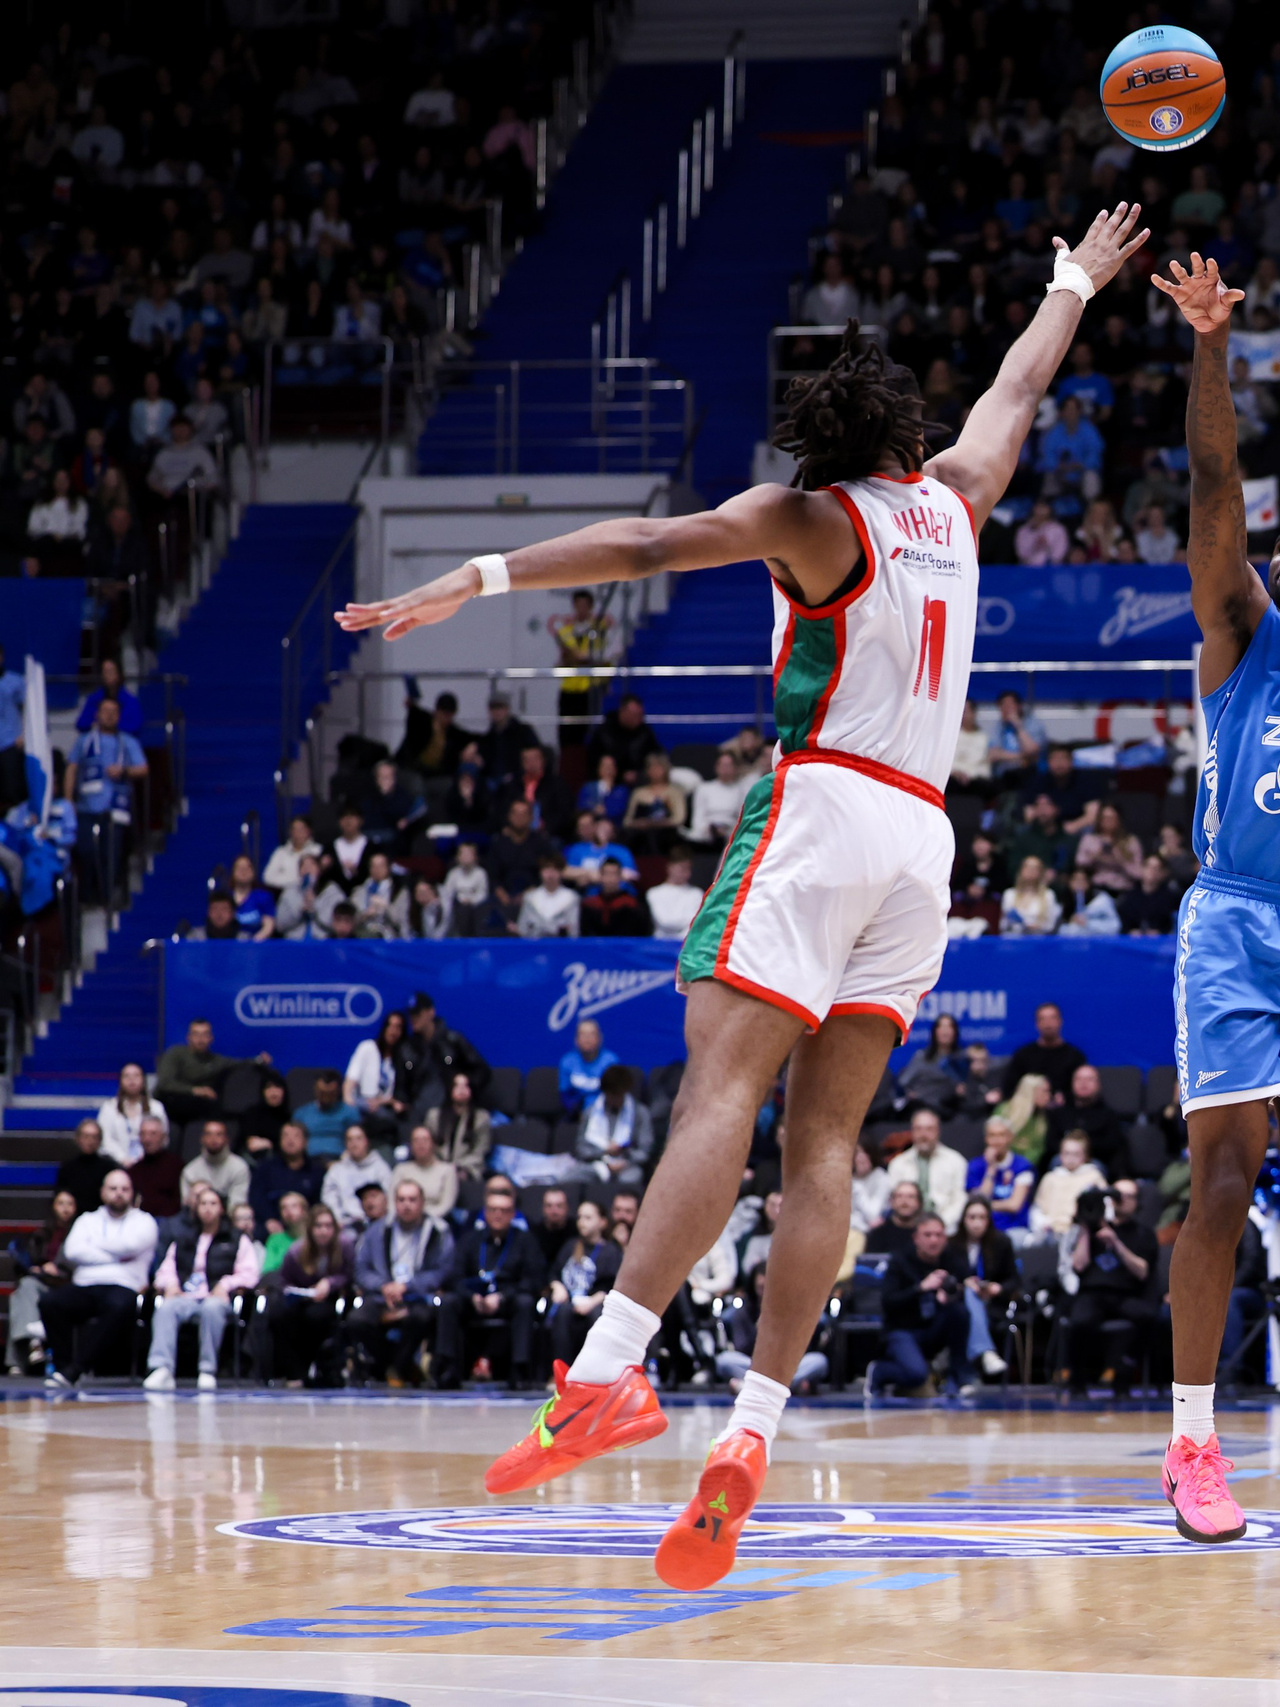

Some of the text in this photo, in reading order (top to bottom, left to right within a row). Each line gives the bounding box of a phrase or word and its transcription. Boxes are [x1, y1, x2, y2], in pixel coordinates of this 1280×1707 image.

[1120, 63, 1199, 94] JÖGEL
[890, 506, 953, 547] WHAEY
[248, 992, 340, 1017] Winline
